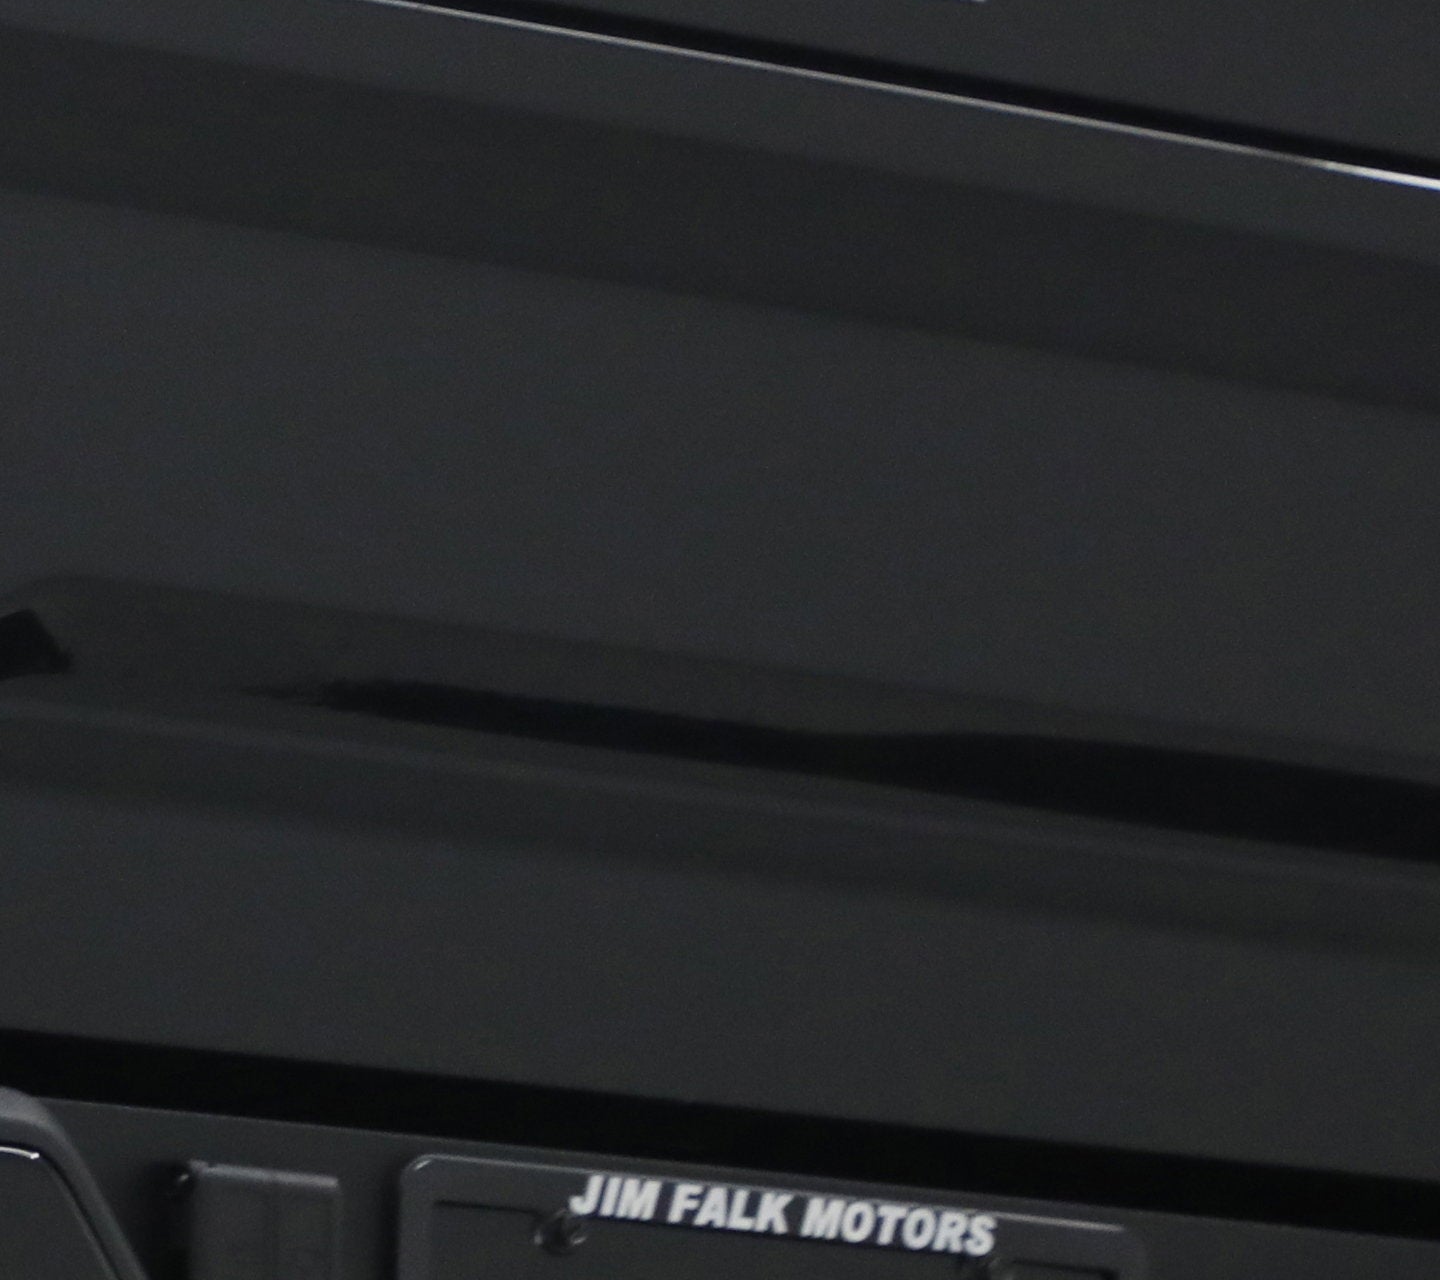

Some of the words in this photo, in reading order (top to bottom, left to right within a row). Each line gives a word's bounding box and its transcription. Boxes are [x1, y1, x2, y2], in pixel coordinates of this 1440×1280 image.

[570, 1175, 657, 1221] JIM
[669, 1183, 791, 1235] FALK
[801, 1196, 997, 1256] MOTORS
